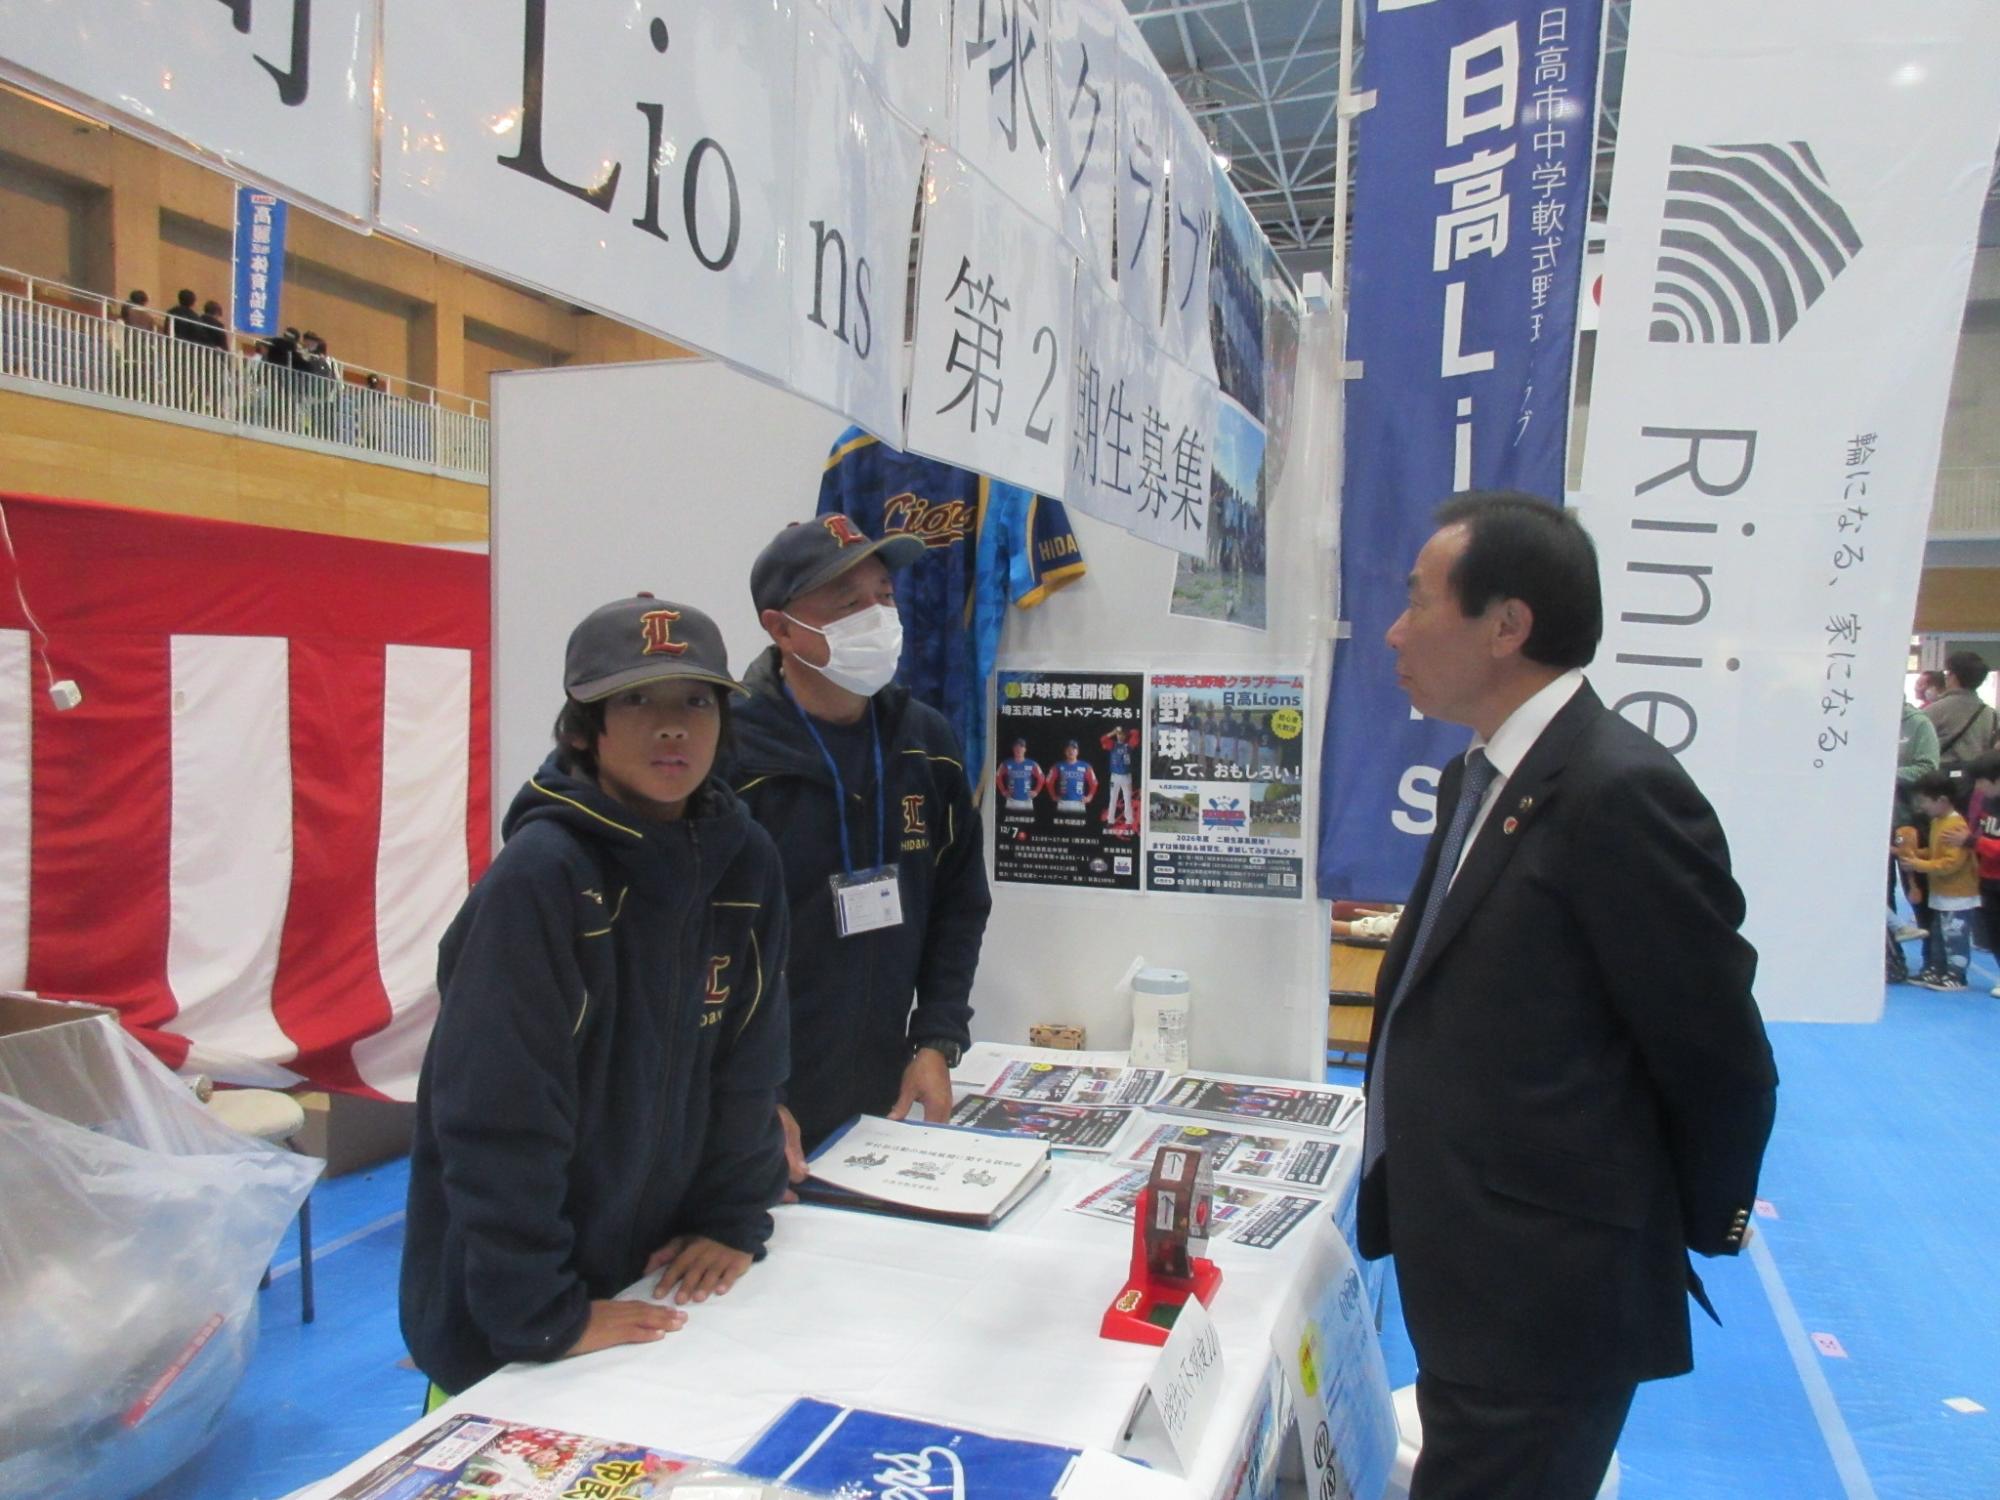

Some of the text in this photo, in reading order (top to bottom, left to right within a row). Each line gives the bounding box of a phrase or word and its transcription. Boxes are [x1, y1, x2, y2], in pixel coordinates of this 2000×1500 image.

[884, 0, 1212, 311] 球クラブ
[936, 255, 1205, 532] 第2期生募集
[823, 515, 863, 548] L
[1812, 431, 1878, 770] 輪になる、家になる。
[640, 609, 689, 657] L
[1020, 682, 1113, 700] 野球教室開催
[1223, 691, 1300, 707] 日高Lions
[1158, 692, 1190, 760] 野球
[1170, 762, 1301, 780] って、おもしろい！
[902, 794, 927, 833] L
